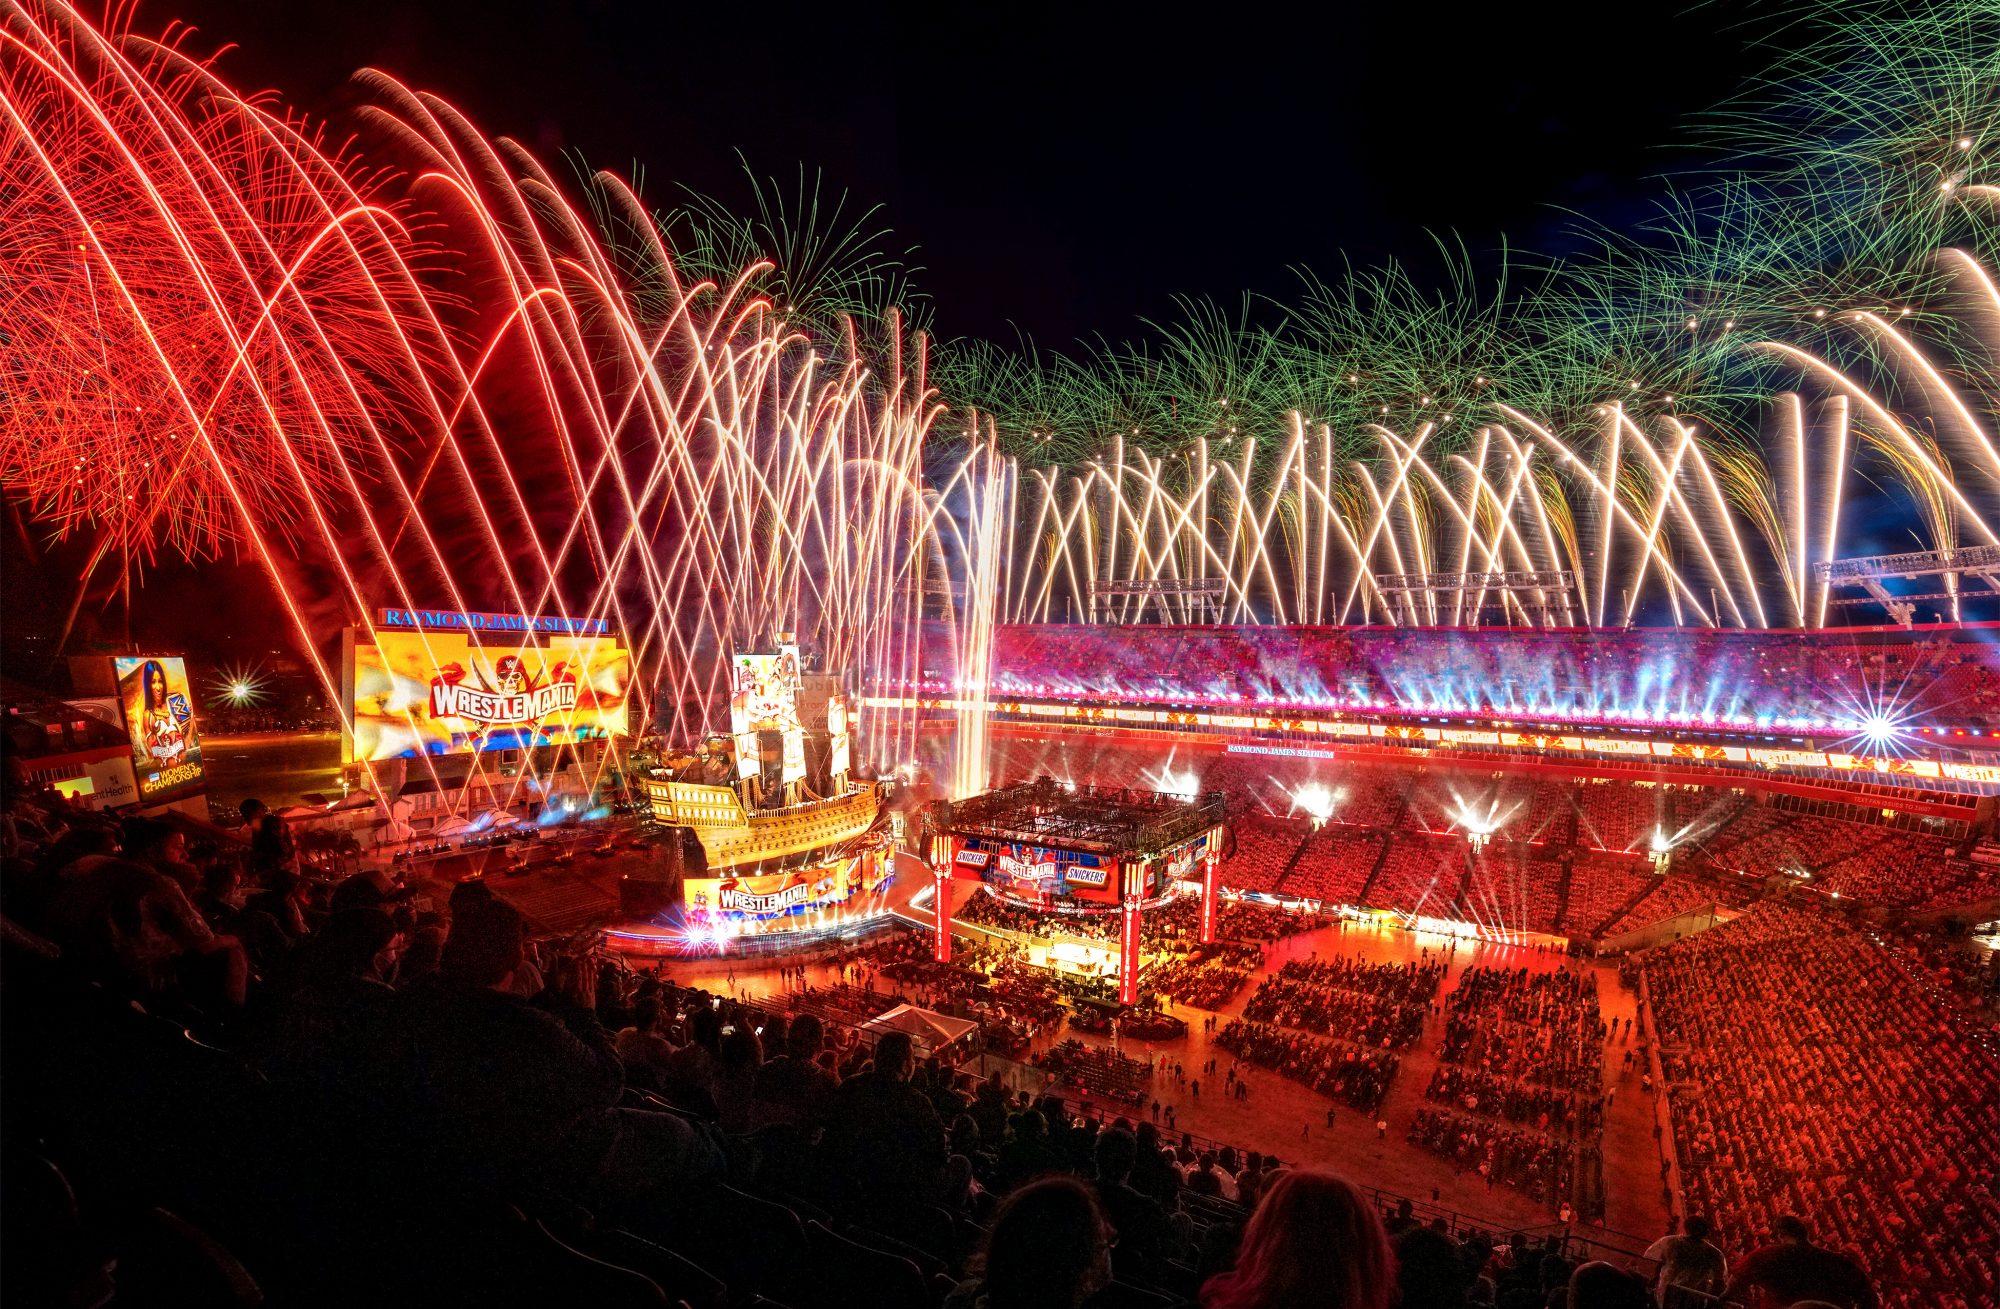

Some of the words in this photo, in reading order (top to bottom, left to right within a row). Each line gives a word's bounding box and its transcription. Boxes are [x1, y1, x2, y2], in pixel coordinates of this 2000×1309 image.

[386, 610, 484, 628] RAYMOND
[545, 618, 607, 633] STADM
[1228, 744, 1268, 755] RAYMOND
[1269, 748, 1296, 756] JAMES
[1297, 750, 1334, 759] STADIUM
[160, 762, 196, 779] WOMEN'S
[144, 767, 202, 793] CHAMPIONSHIP
[957, 851, 986, 865] SNICKERS
[1068, 869, 1105, 883] SNICKERS
[721, 885, 808, 911] WRESTLEMANIA
